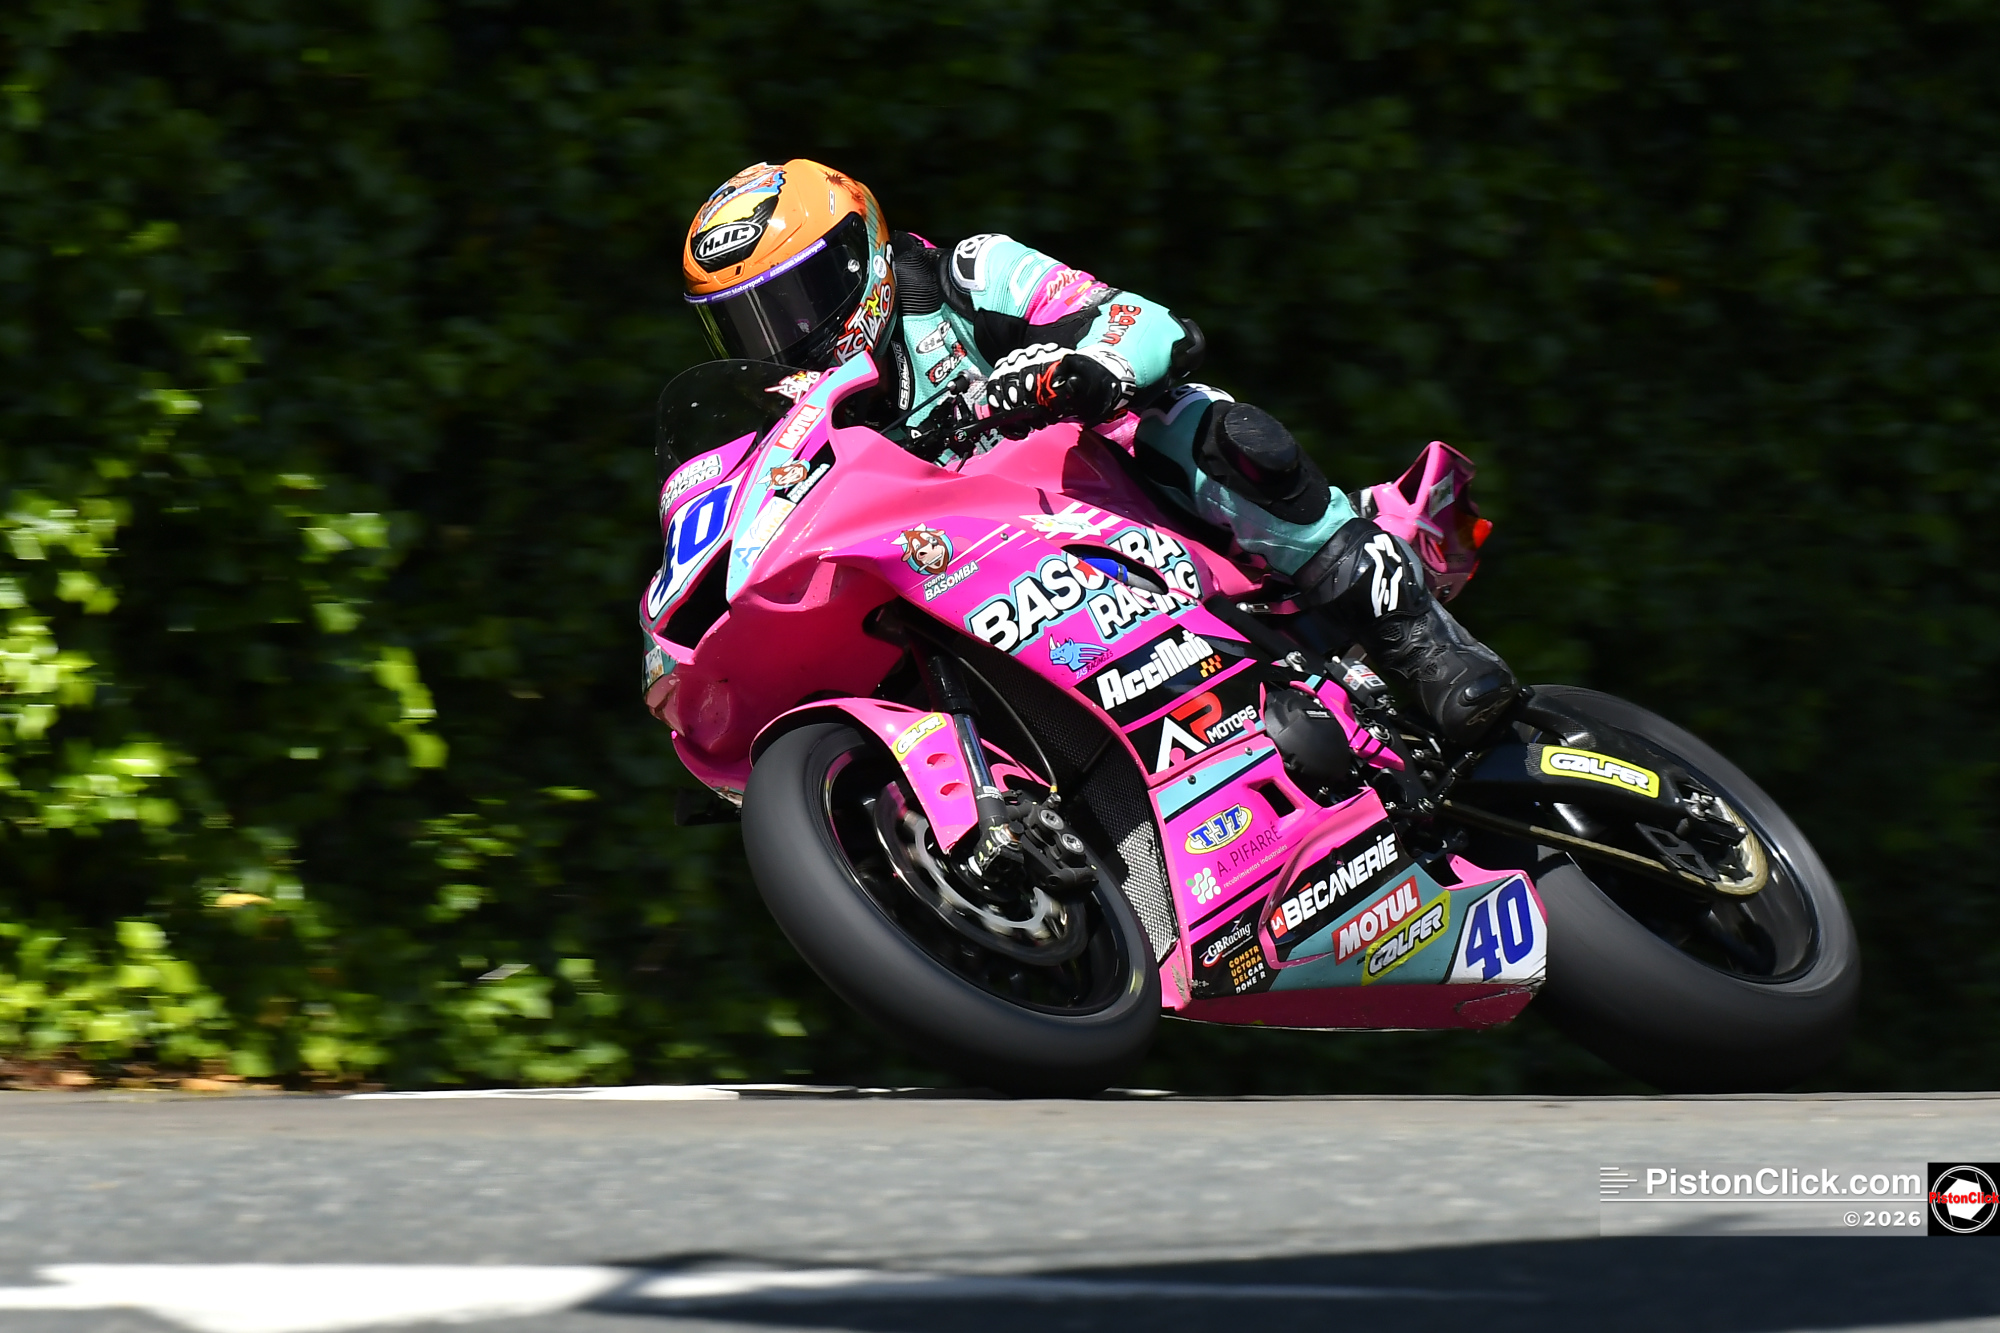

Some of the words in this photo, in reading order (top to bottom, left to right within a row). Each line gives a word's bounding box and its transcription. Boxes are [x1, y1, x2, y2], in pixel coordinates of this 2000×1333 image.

[703, 226, 749, 255] HJC
[778, 406, 822, 449] MOTUL
[923, 573, 946, 590] TORITO
[925, 561, 979, 601] BASOMBA
[1096, 629, 1214, 710] AcciMoto
[1206, 704, 1258, 744] MOTORS
[1190, 804, 1242, 849] TJT
[1217, 860, 1231, 877] A.
[1229, 821, 1282, 867] PIFARRÉ
[1223, 862, 1261, 888] recubrimientos
[1260, 844, 1288, 865] industriales
[1207, 922, 1252, 957] GBRacing
[1337, 880, 1420, 960] MOTUL
[1465, 877, 1534, 981] 40
[1228, 945, 1259, 968] CONSTR
[1231, 954, 1262, 977] UCTORA
